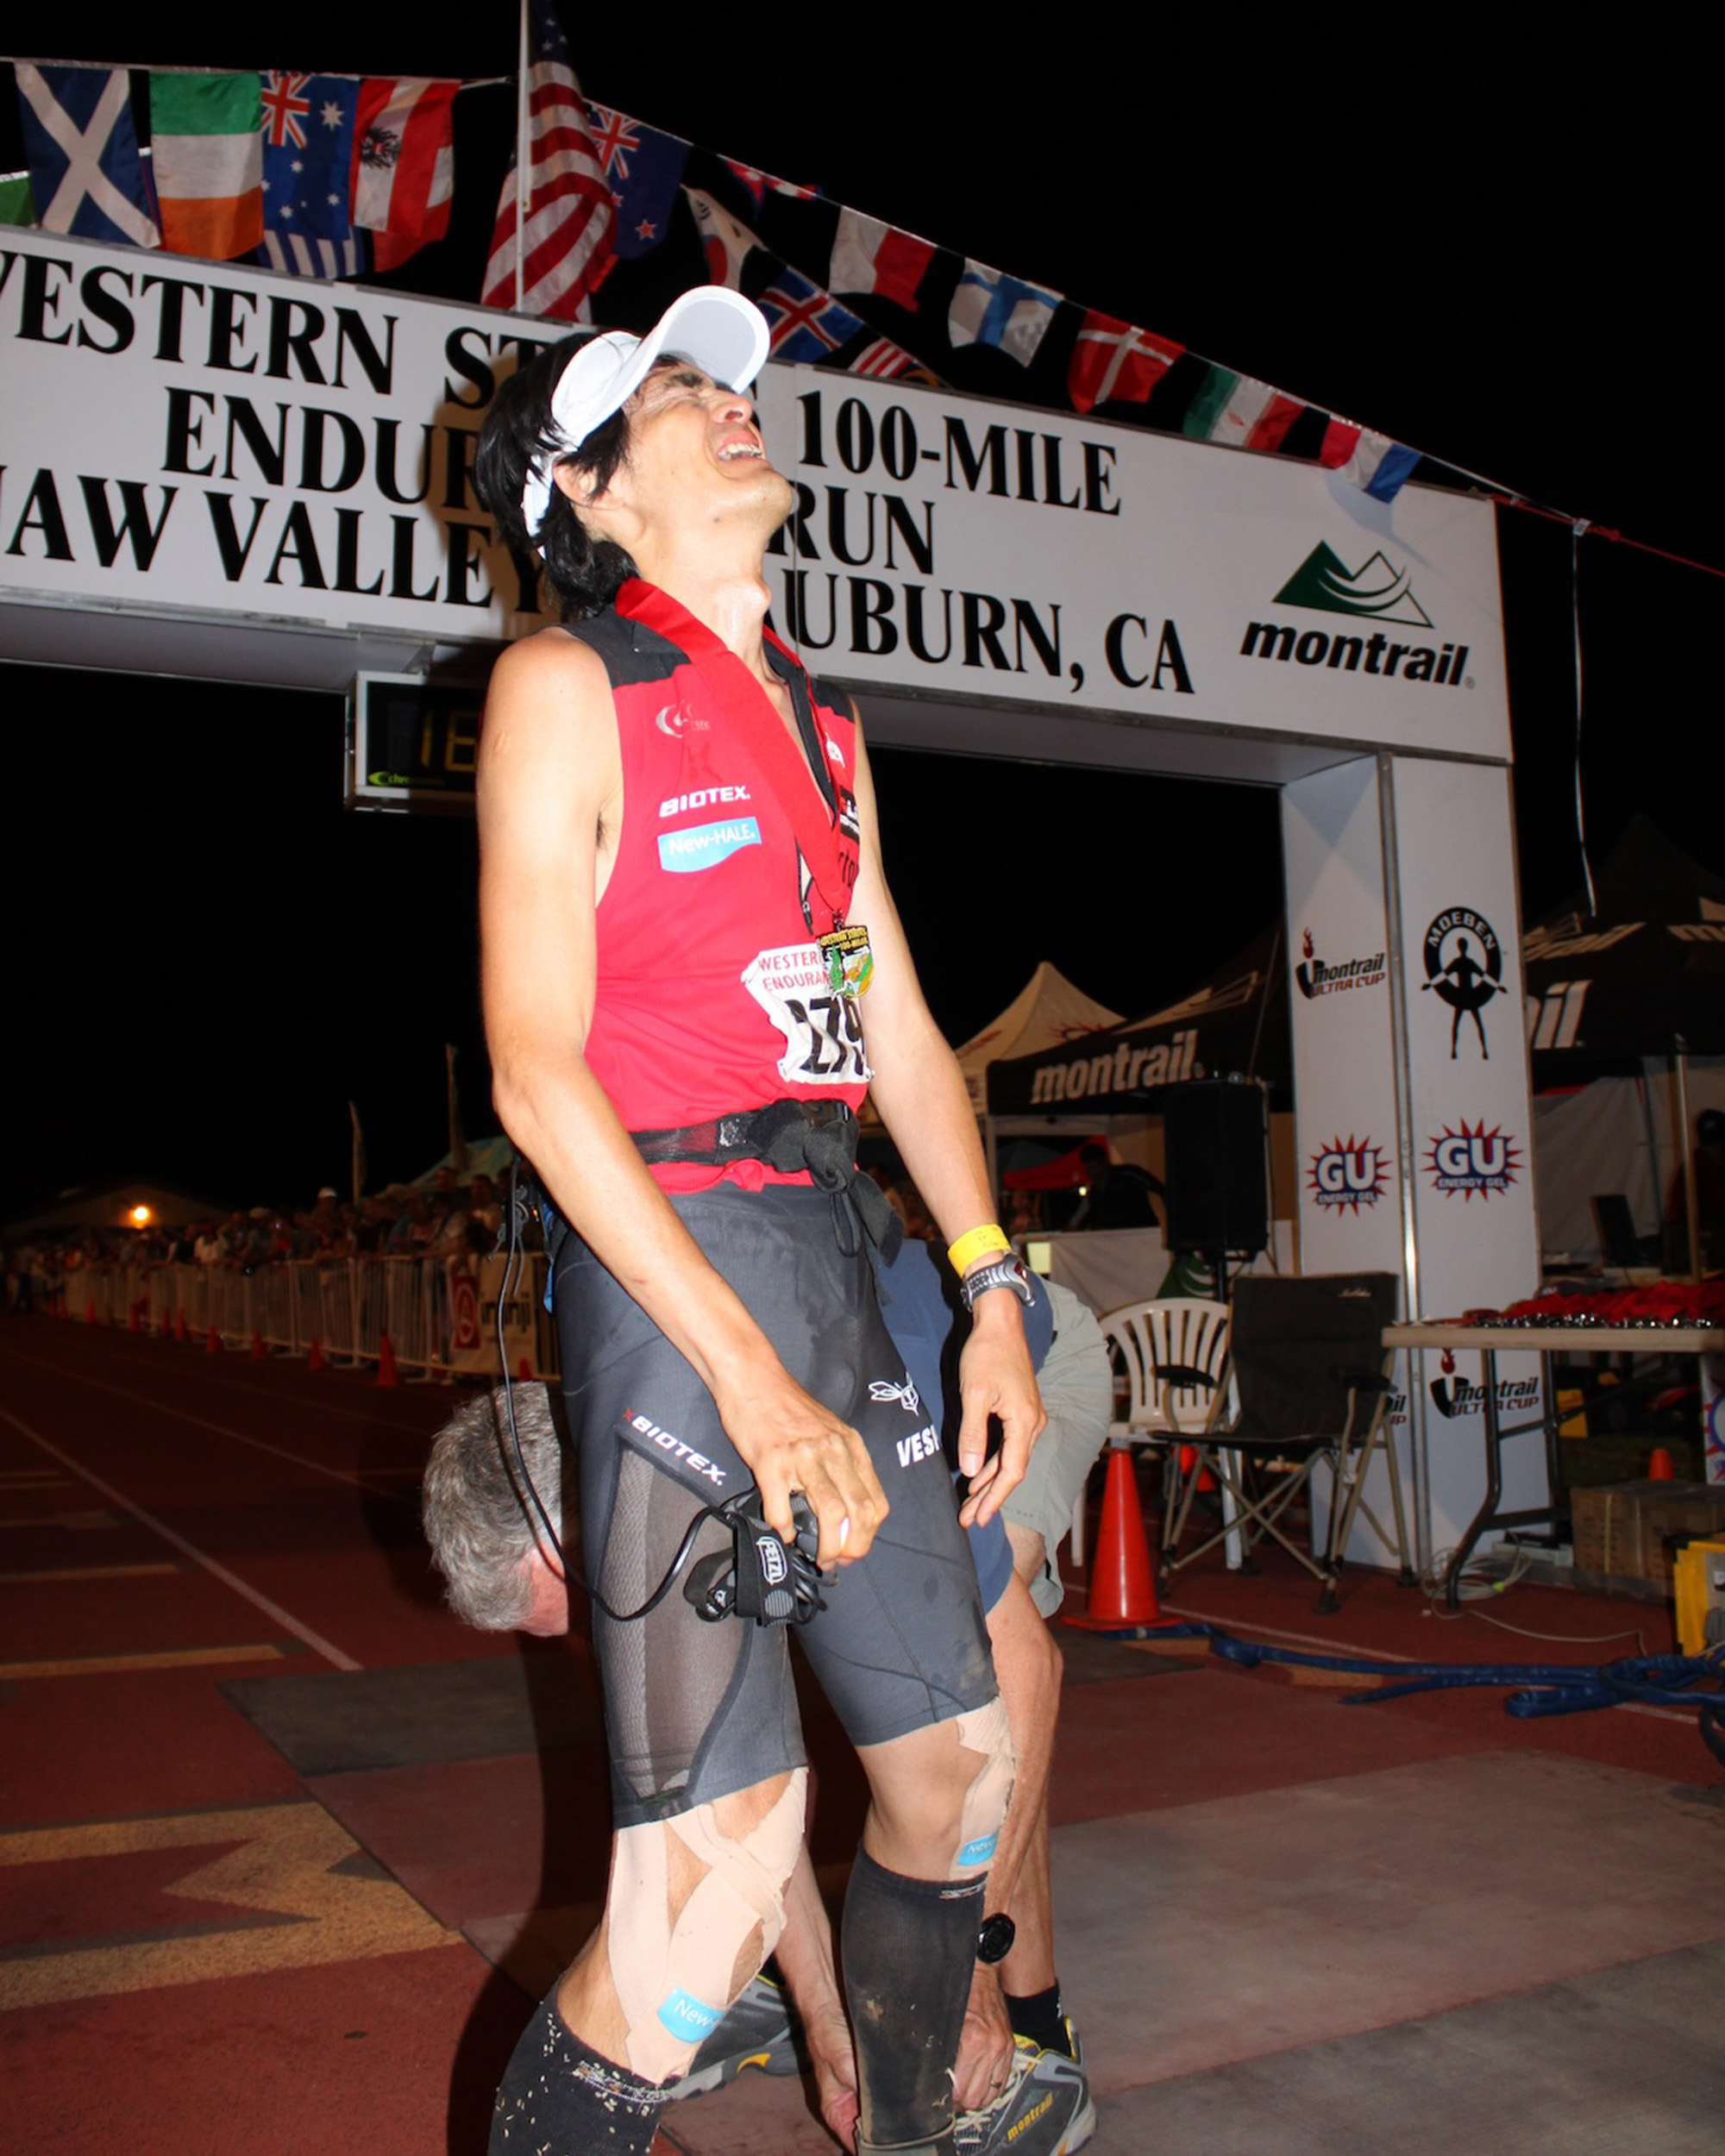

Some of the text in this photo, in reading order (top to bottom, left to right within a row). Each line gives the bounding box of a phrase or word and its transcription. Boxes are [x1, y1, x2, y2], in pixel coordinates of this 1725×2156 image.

[796, 390, 1120, 516] 100-MILE
[161, 385, 935, 575] ENDUR RUN
[0, 465, 179, 572] AW
[764, 567, 1085, 693] UBURN,
[1105, 612, 1195, 694] CA
[1239, 621, 1469, 687] montrail
[1427, 911, 1496, 950] MOEBEN
[1311, 972, 1386, 997] ULTRA CUP
[1313, 952, 1386, 984] montrail
[1030, 1029, 1199, 1105] montrail
[1316, 1151, 1377, 1193] GU
[1435, 1137, 1507, 1177] GU
[1438, 1177, 1507, 1188] ENERGY GEL
[1456, 1377, 1540, 1402] motrail
[1507, 1396, 1540, 1411] CUP
[896, 1425, 939, 1468] VES
[674, 1999, 718, 2028] New-
[1007, 2090, 1054, 2142] montrail
